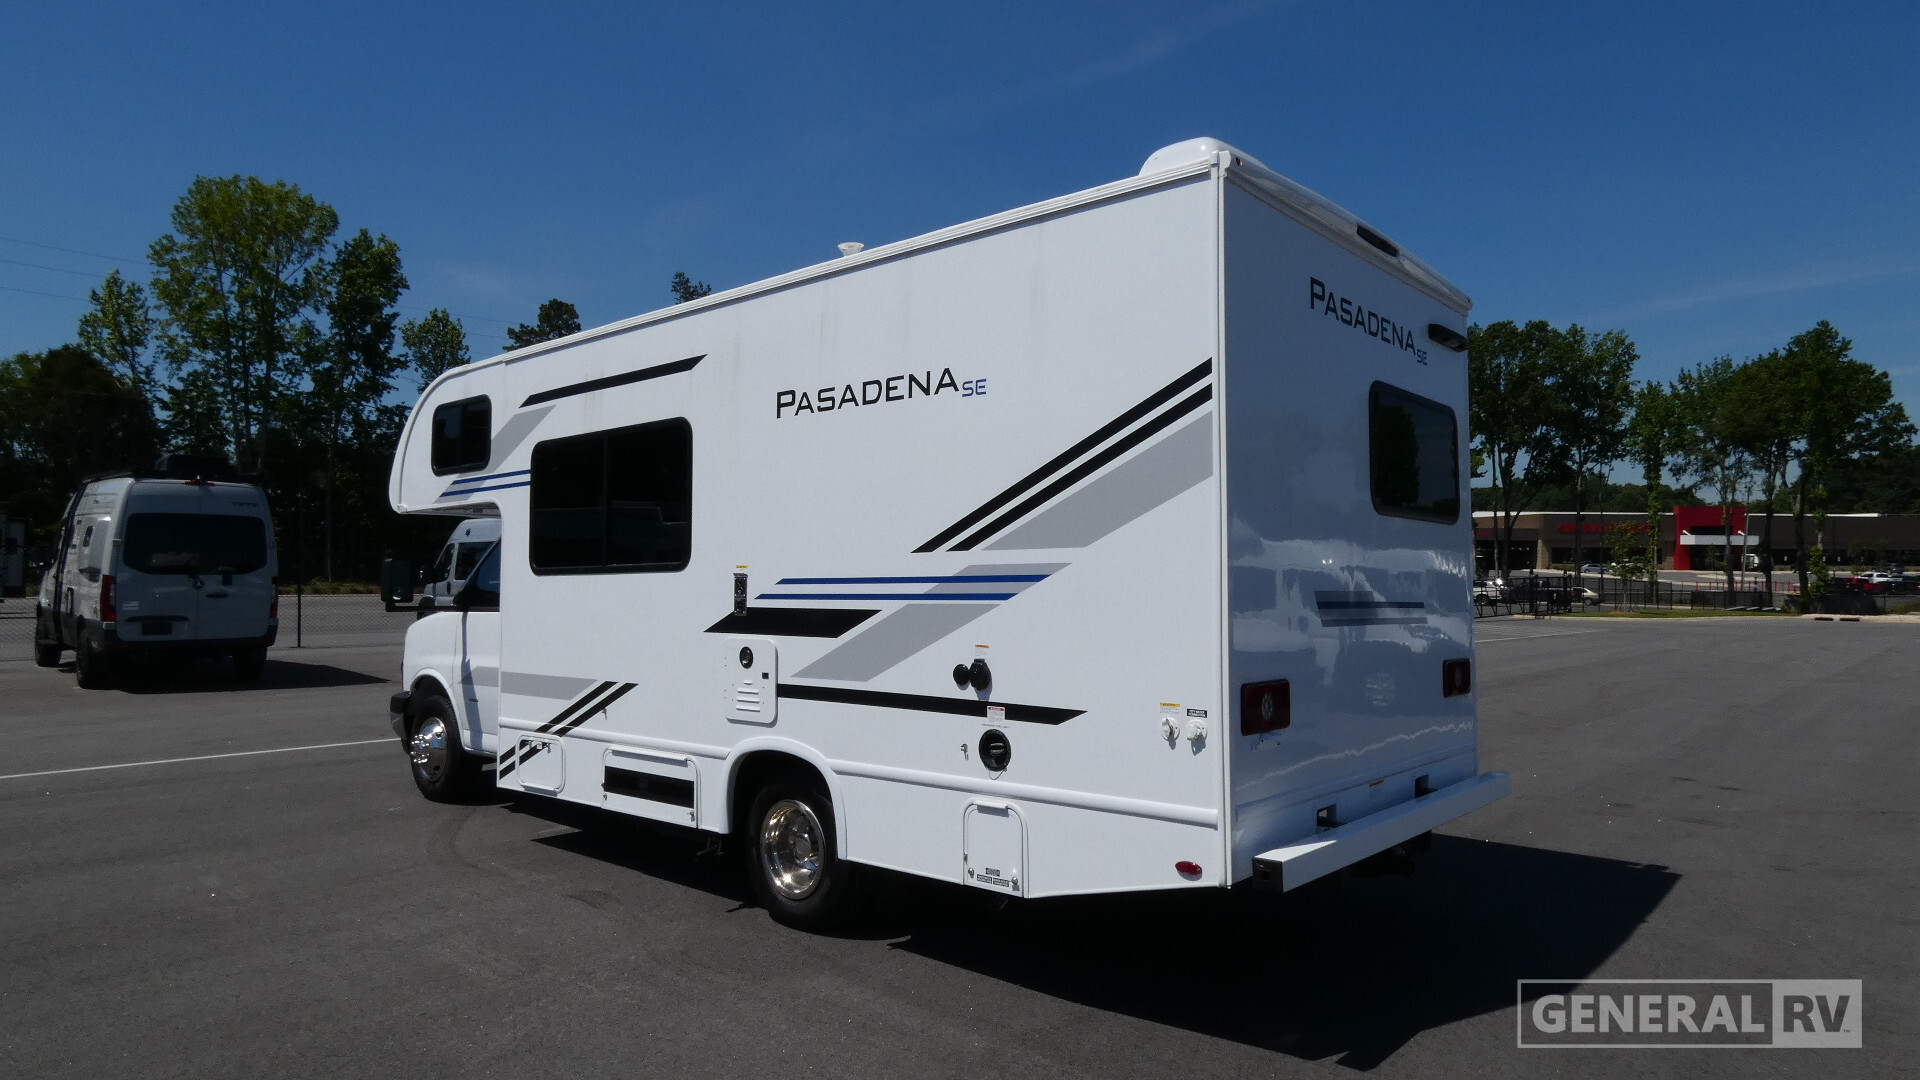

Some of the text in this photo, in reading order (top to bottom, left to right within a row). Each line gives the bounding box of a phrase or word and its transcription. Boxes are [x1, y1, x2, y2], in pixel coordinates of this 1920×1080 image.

[1310, 276, 1428, 366] PASADENA SE
[776, 367, 987, 419] PASADENA SE
